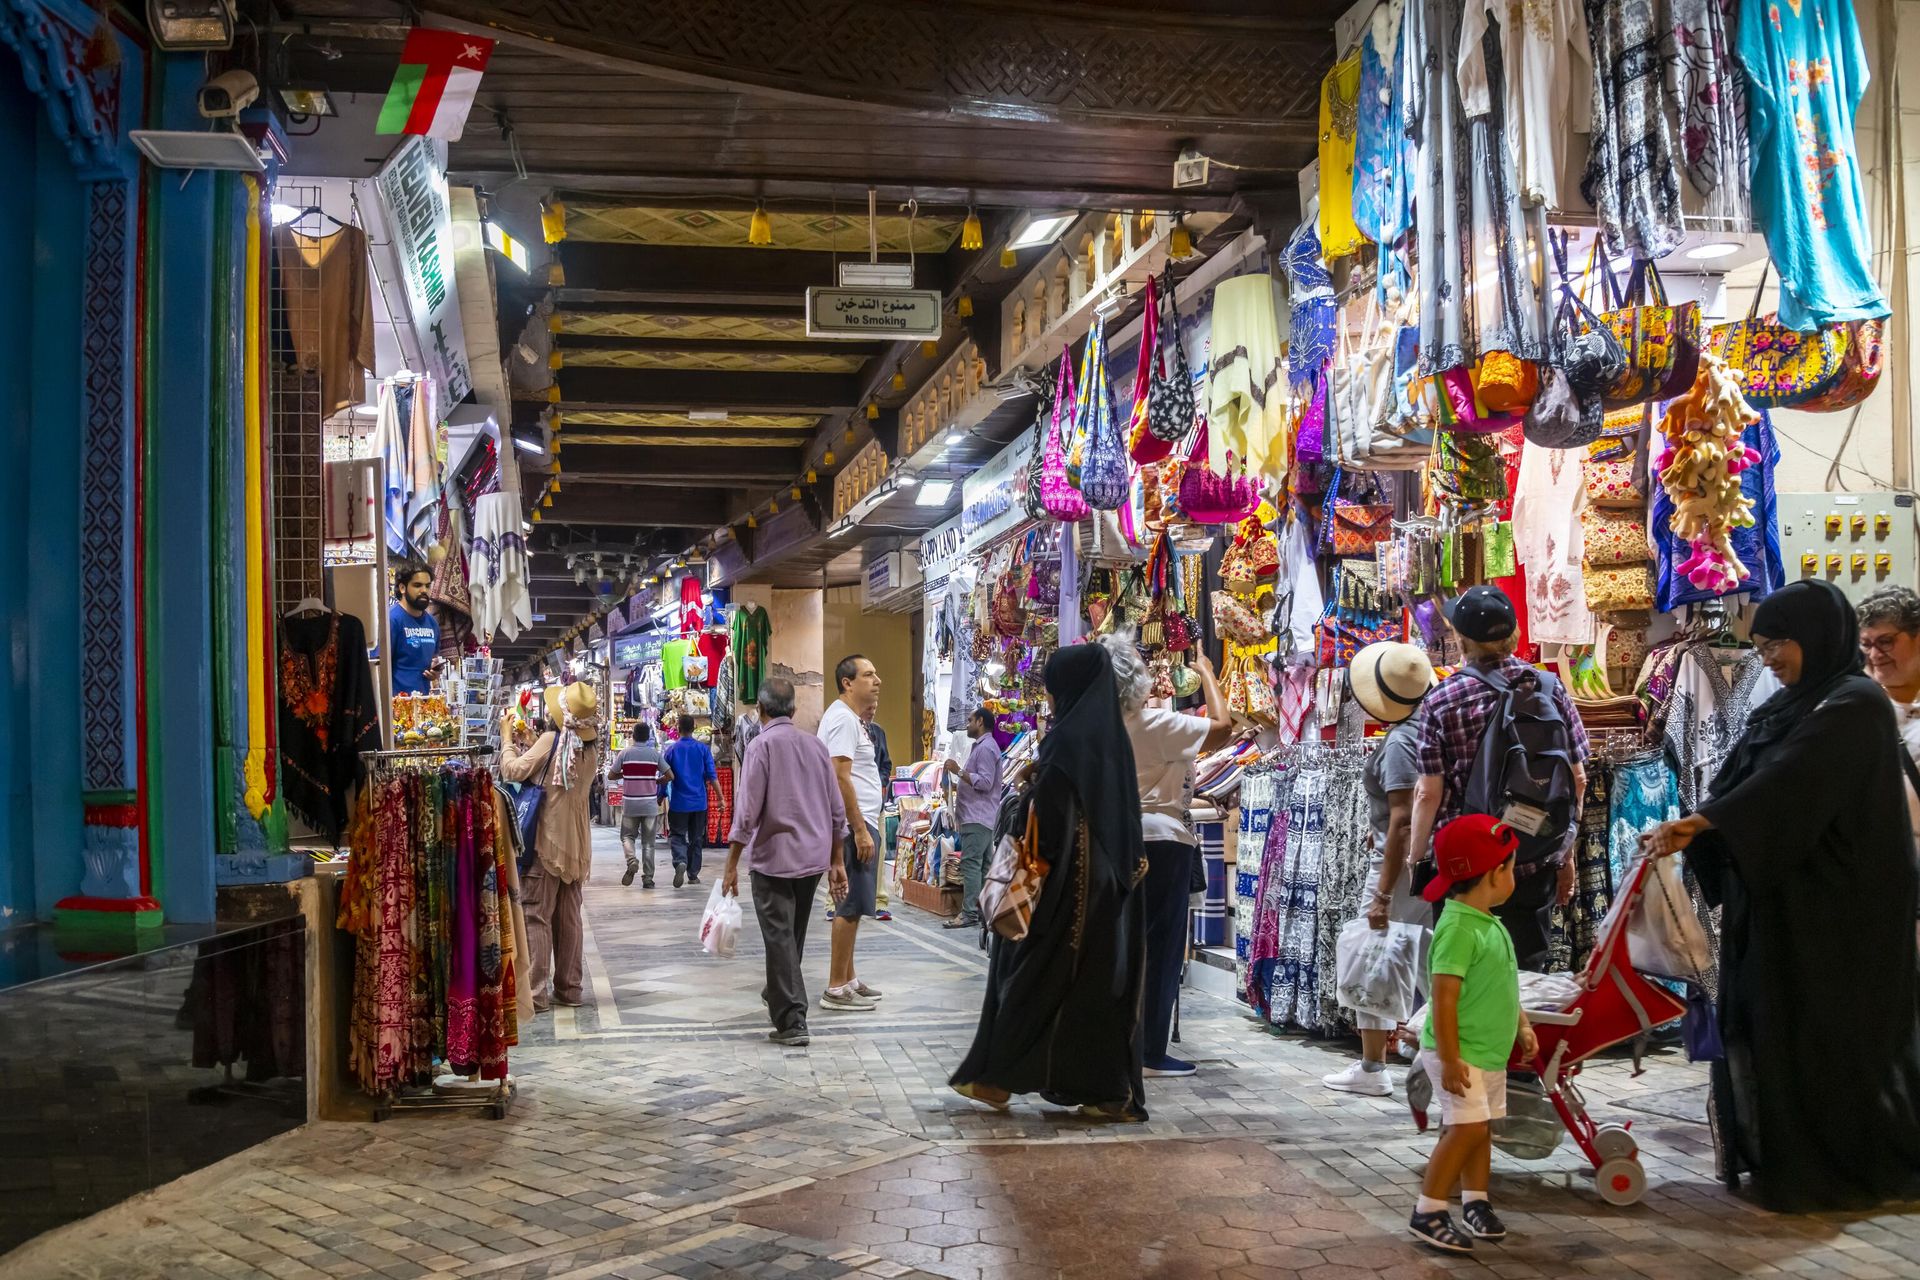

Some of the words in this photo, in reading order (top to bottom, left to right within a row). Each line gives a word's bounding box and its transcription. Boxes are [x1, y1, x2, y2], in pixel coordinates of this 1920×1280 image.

[398, 141, 434, 242] HEAVEN
[416, 229, 446, 316] KASHMIR
[835, 297, 879, 312] التدخين
[882, 300, 915, 313] ممنوع
[845, 315, 859, 325] No
[862, 315, 906, 328] Smoking
[920, 537, 938, 568] HAPPY
[938, 527, 956, 558] LAND
